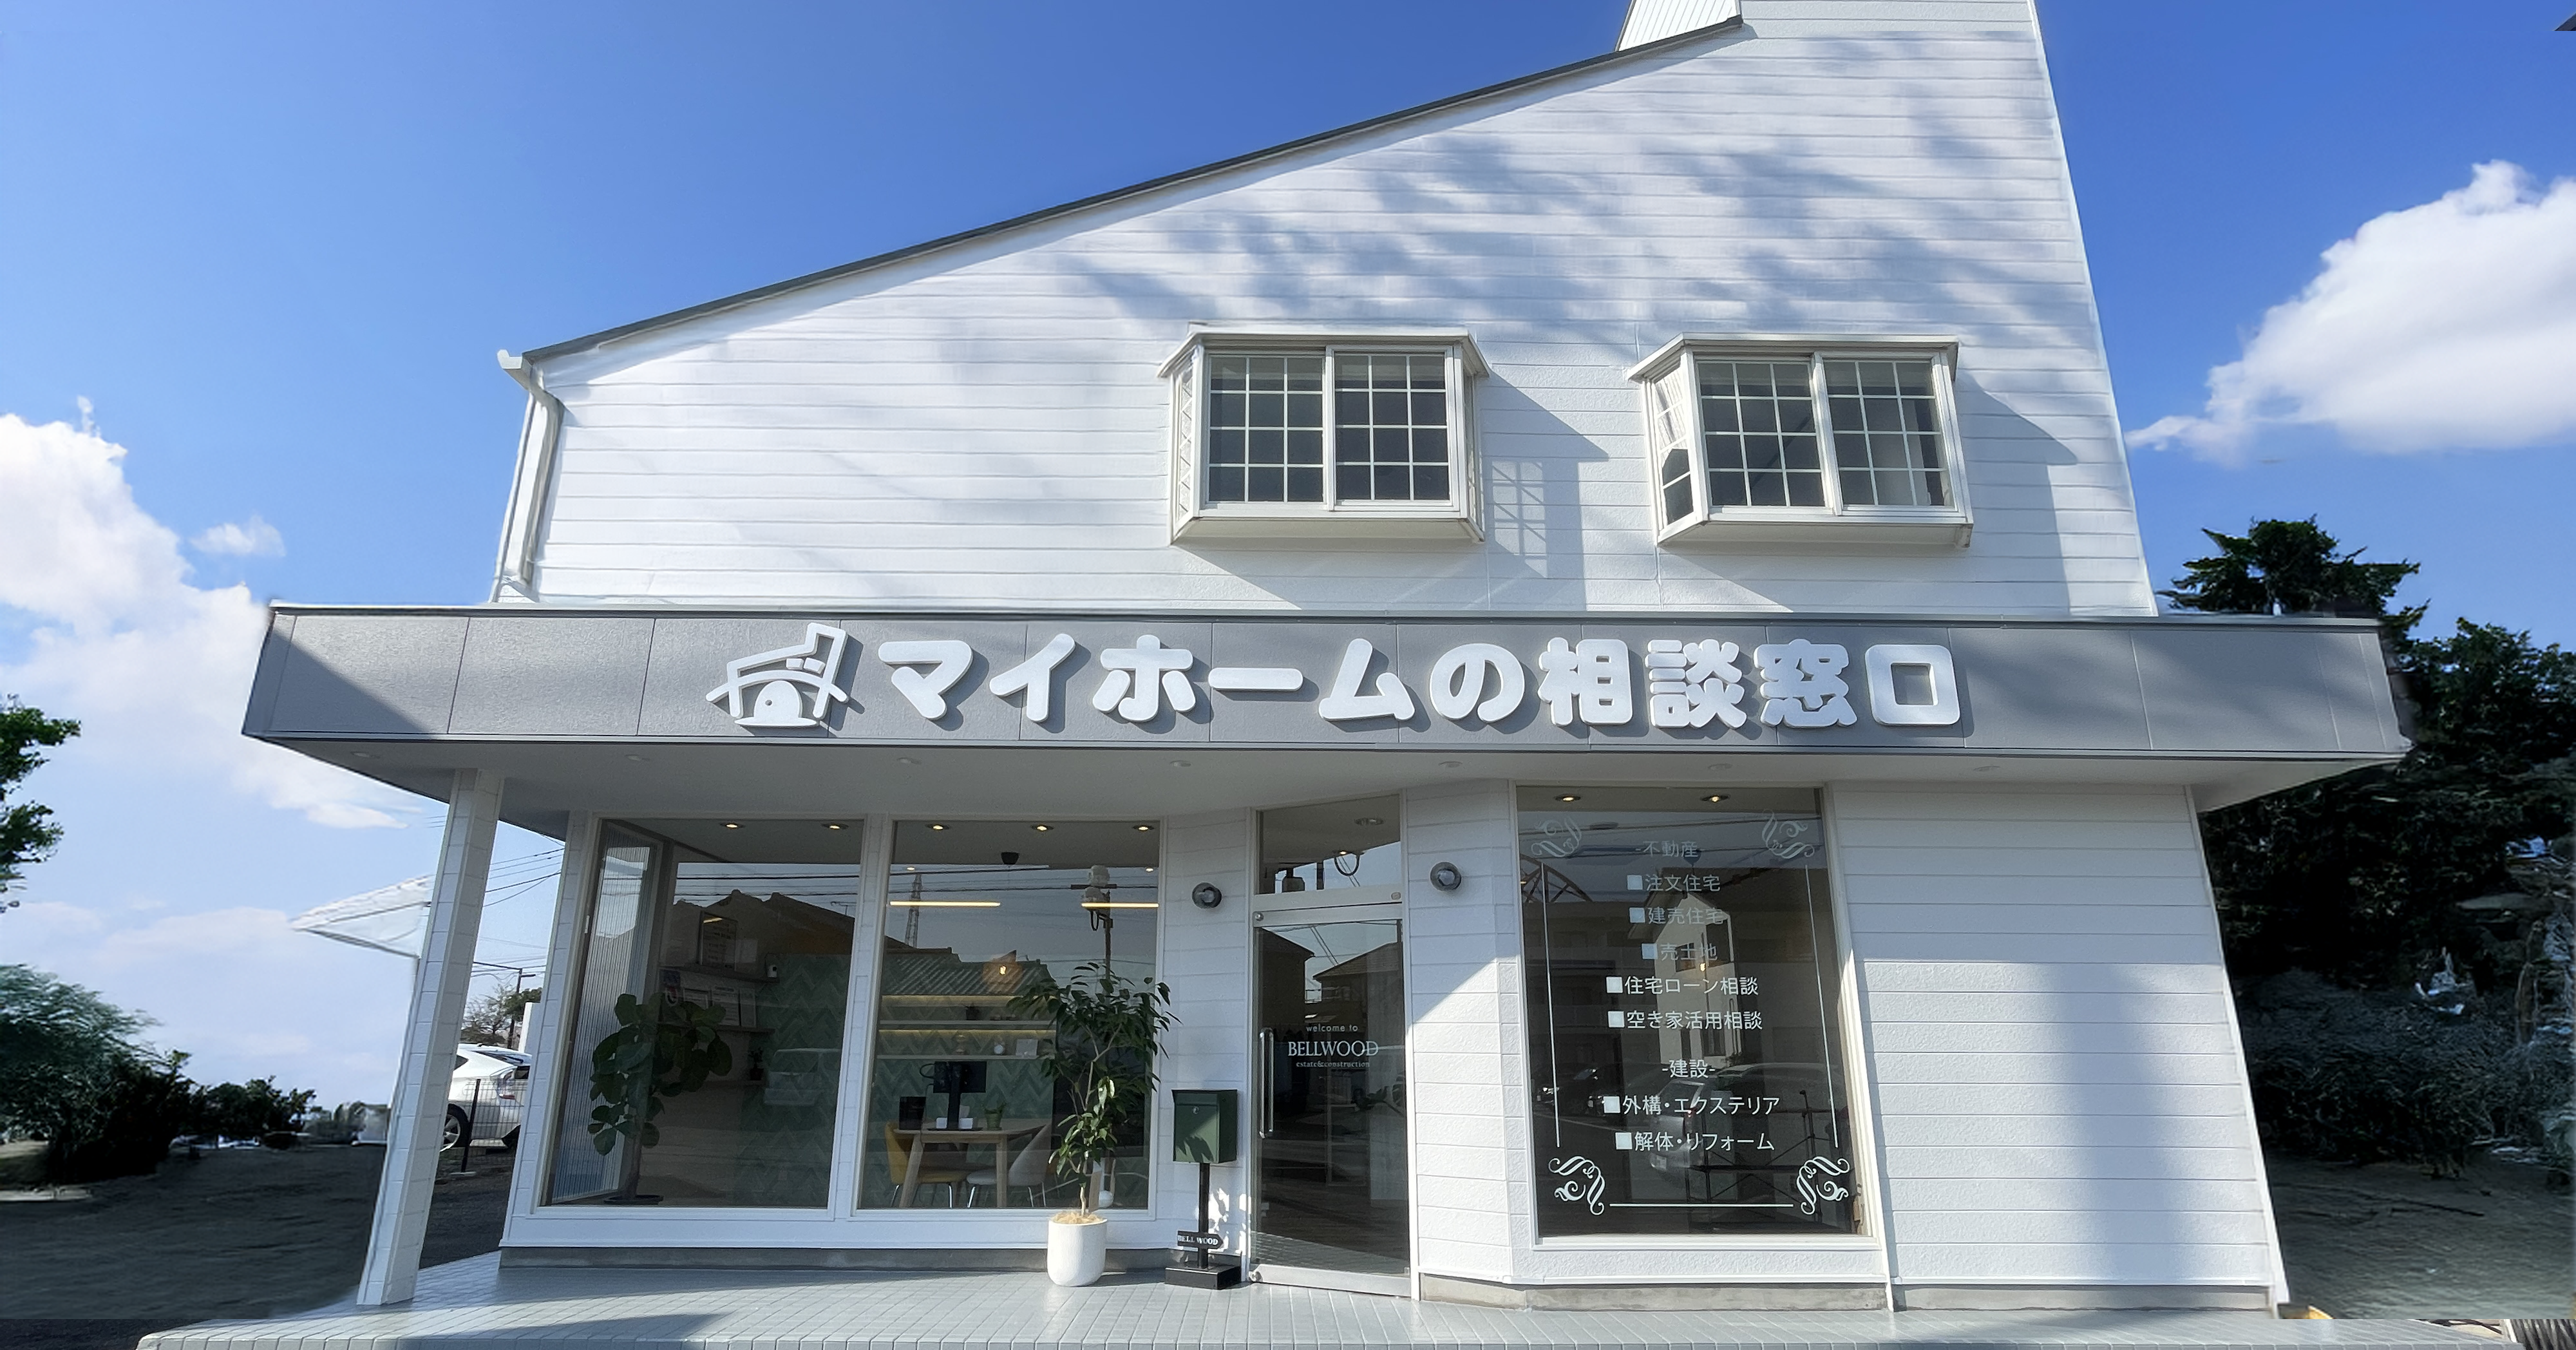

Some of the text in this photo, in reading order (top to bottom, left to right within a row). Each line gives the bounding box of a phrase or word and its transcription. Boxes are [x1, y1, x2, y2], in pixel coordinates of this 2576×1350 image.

[878, 633, 1961, 728] マイホームの相談窓口
[1645, 874, 1721, 892] 注文住宅
[1648, 907, 1723, 924] 建売住宅
[1660, 942, 1718, 961] 売土地
[1624, 976, 1759, 995] 住宅ローン相談
[1306, 1023, 1345, 1032] welcome
[1626, 1010, 1763, 1030] 空き家活用相談
[1288, 1040, 1379, 1056] BELLWOOD
[1177, 1235, 1219, 1246] BELL WOOD
